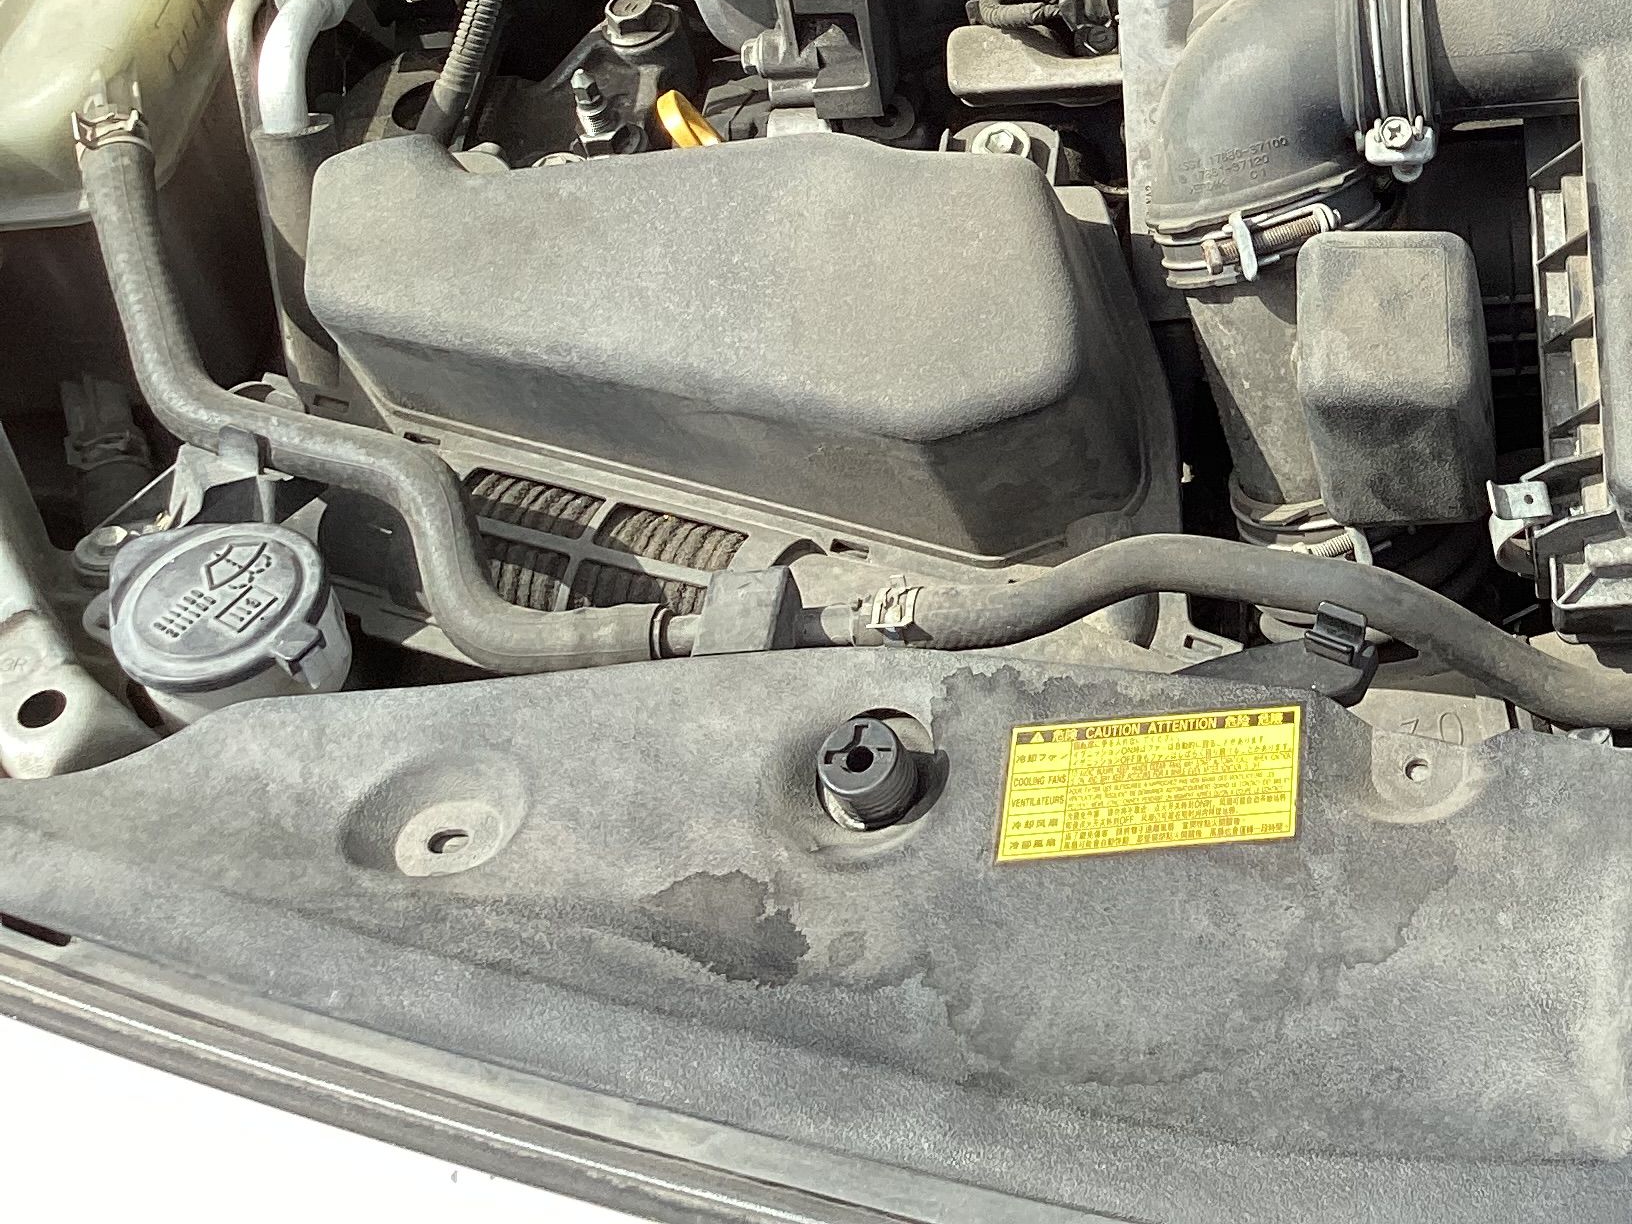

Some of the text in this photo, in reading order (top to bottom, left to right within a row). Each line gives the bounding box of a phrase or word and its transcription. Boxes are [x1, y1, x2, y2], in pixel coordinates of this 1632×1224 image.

[1085, 722, 1141, 740] CAUTION
[1148, 716, 1218, 735] ATTENTION
[1013, 774, 1067, 788] COOLING FANS
[1011, 794, 1065, 809] VENTILATEURS
